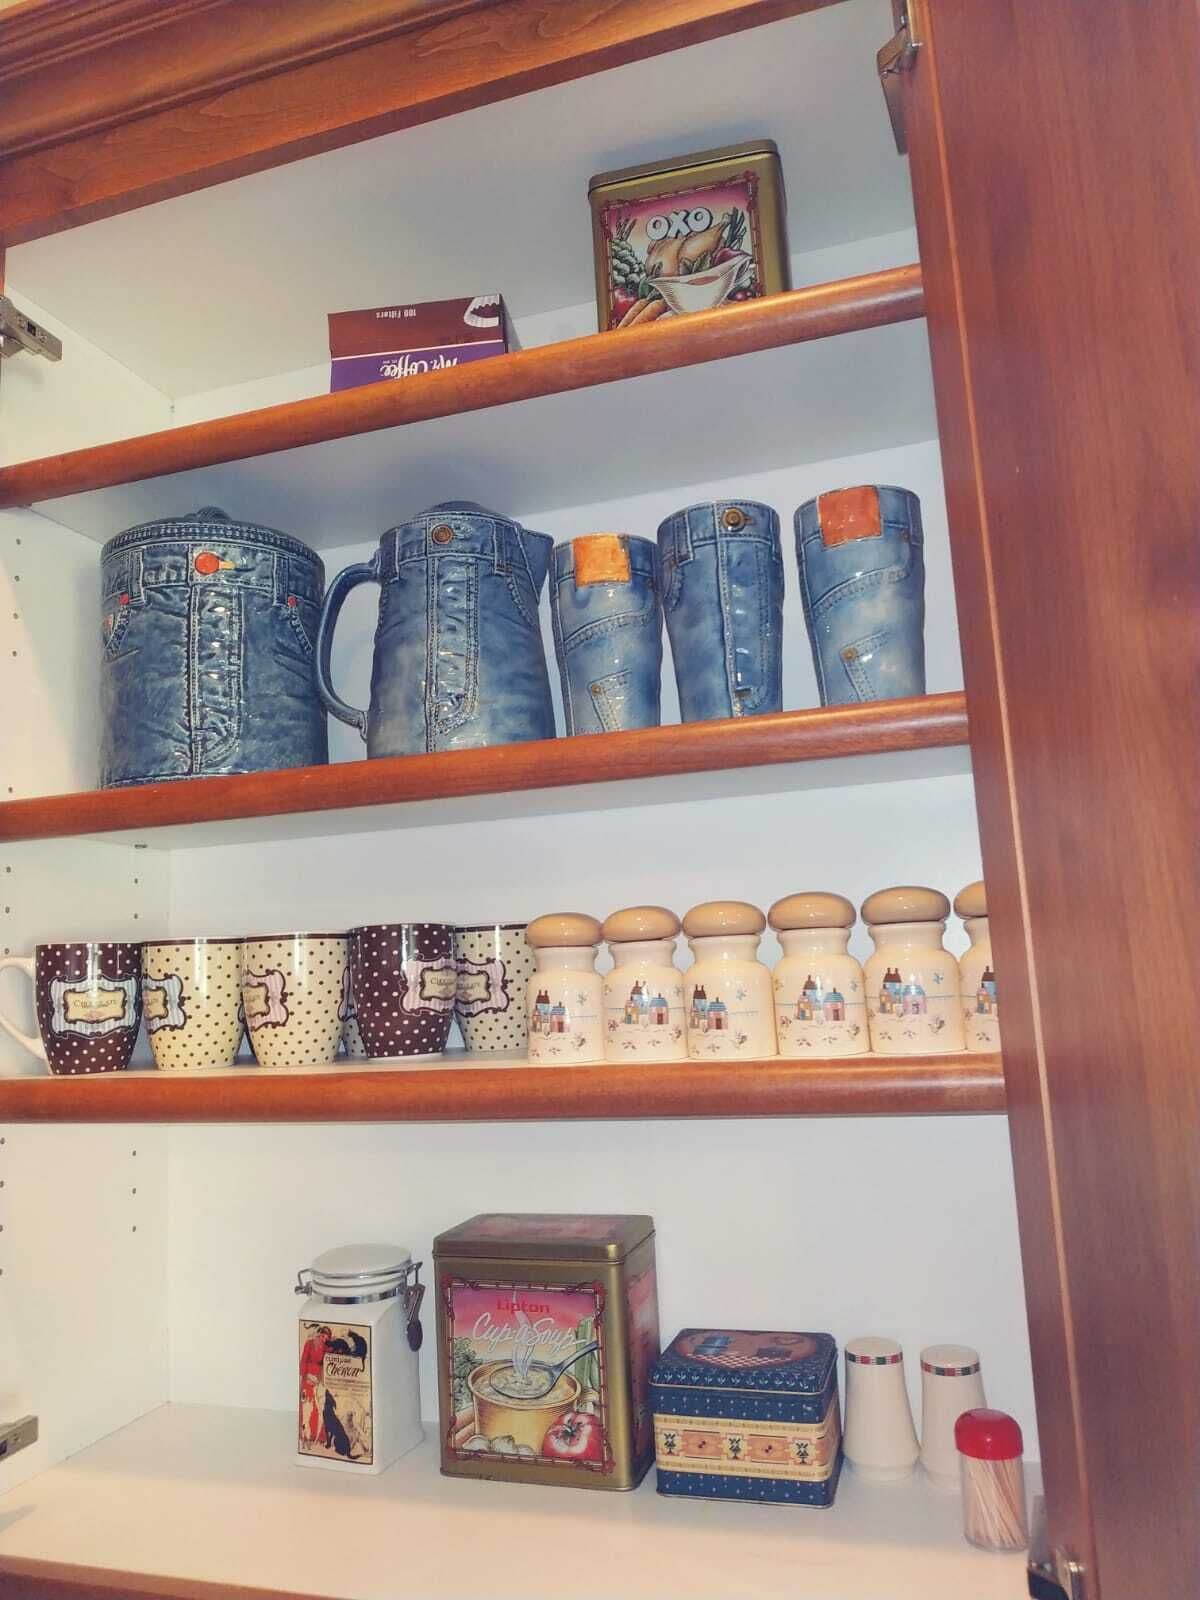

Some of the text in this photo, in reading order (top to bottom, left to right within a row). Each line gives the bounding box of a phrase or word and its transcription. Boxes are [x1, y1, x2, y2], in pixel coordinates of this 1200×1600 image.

[646, 206, 713, 240] OXO
[376, 308, 416, 320] 100 Filters
[380, 353, 428, 380] Coffee
[496, 1300, 550, 1314] Lipton
